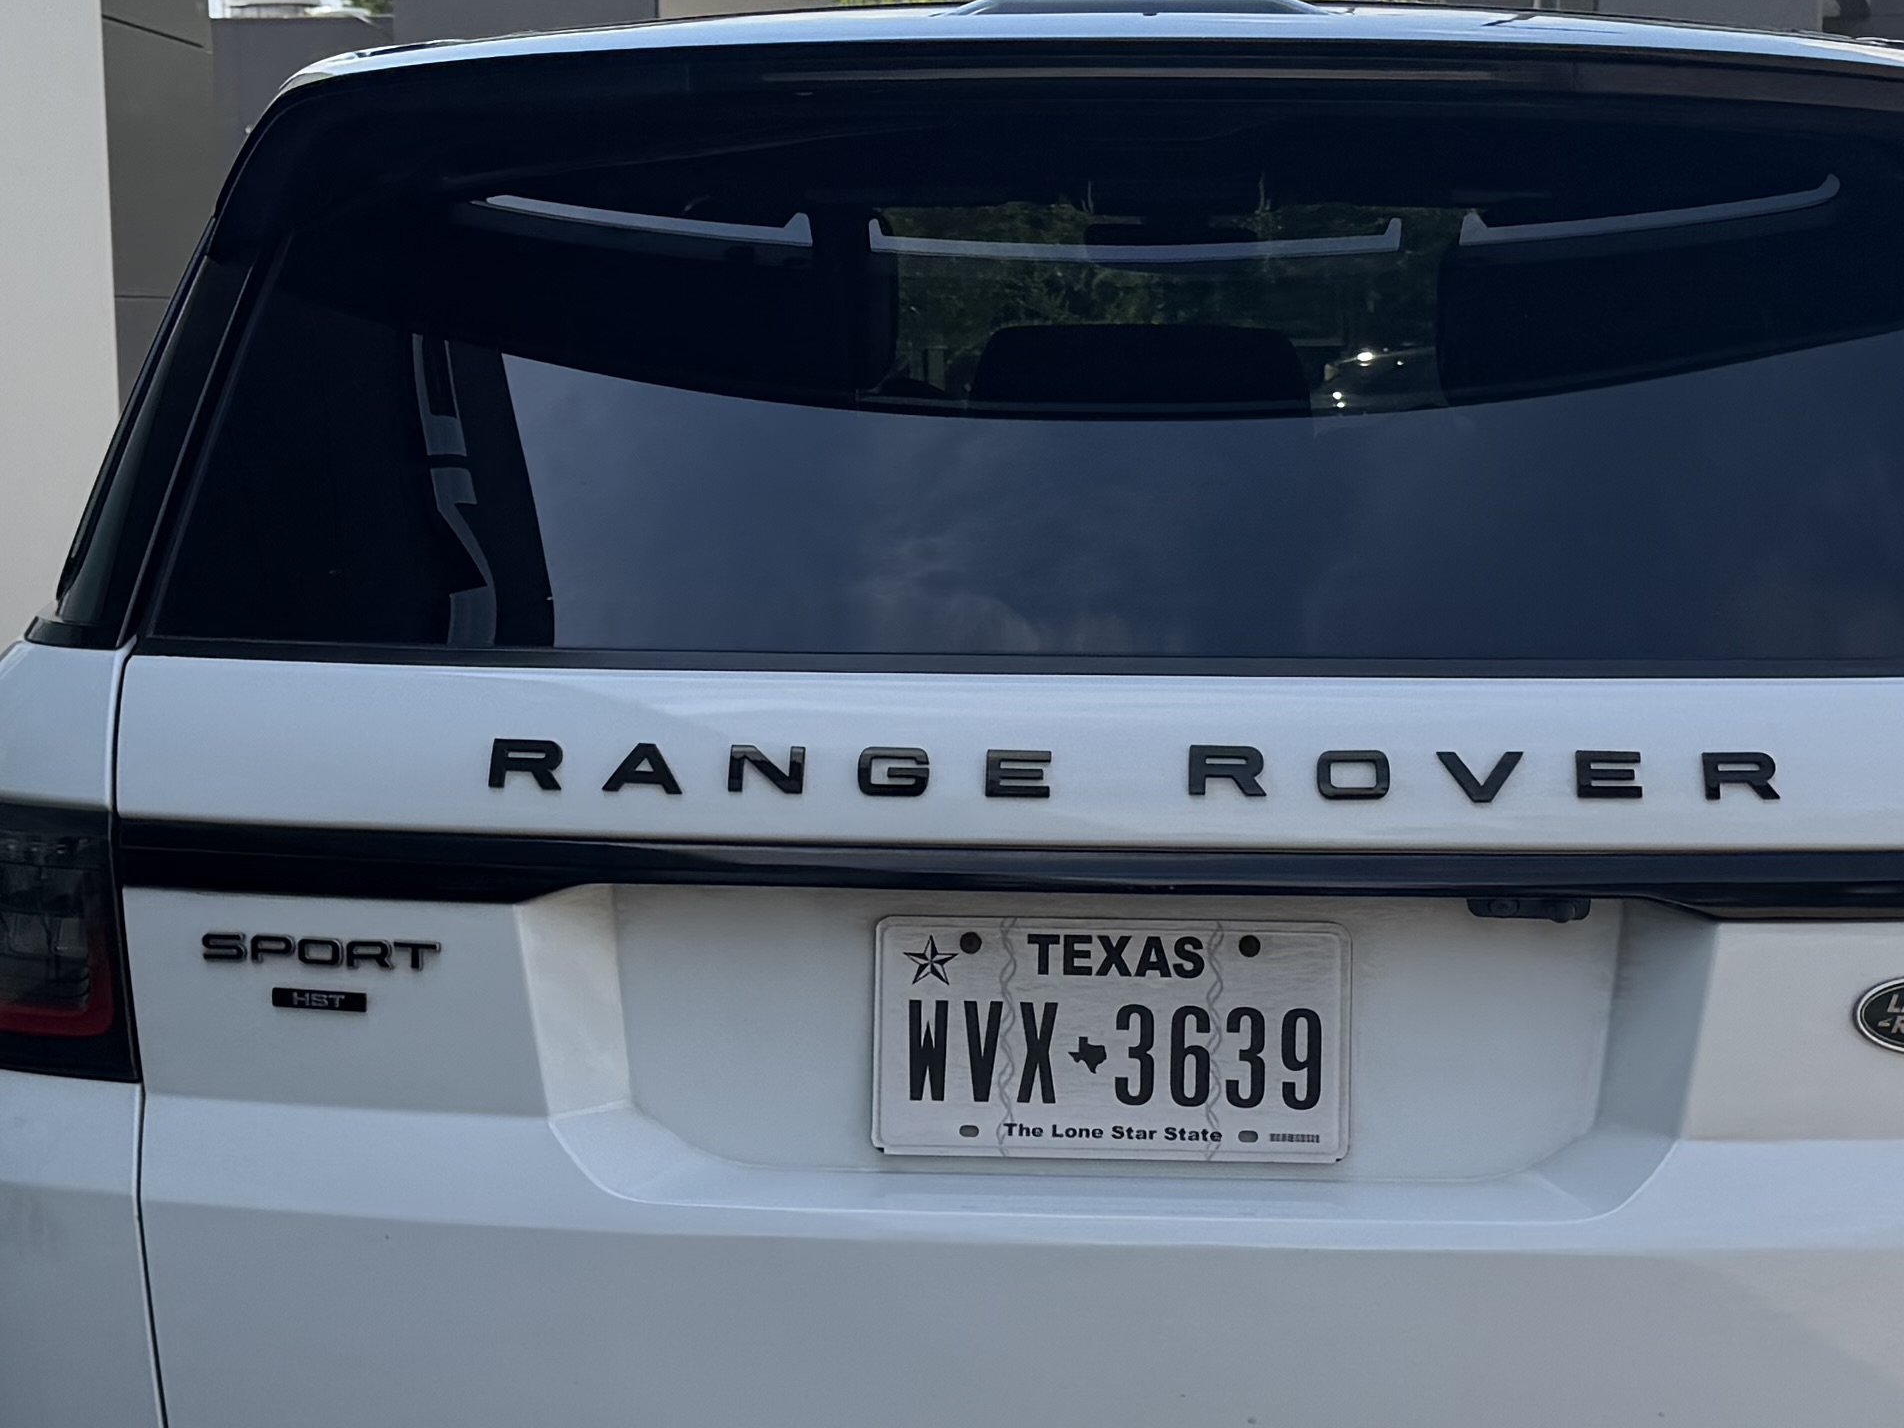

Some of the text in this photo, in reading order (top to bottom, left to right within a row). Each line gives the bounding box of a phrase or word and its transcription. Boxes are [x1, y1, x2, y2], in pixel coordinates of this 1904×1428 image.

[487, 737, 1781, 803] RANGE ROVER
[201, 932, 442, 972] SPORT
[1027, 934, 1205, 979] TEXAS
[292, 991, 345, 1008] HST
[908, 999, 1323, 1110] WVX 3639
[1003, 1122, 1223, 1143] The Lone Star State
